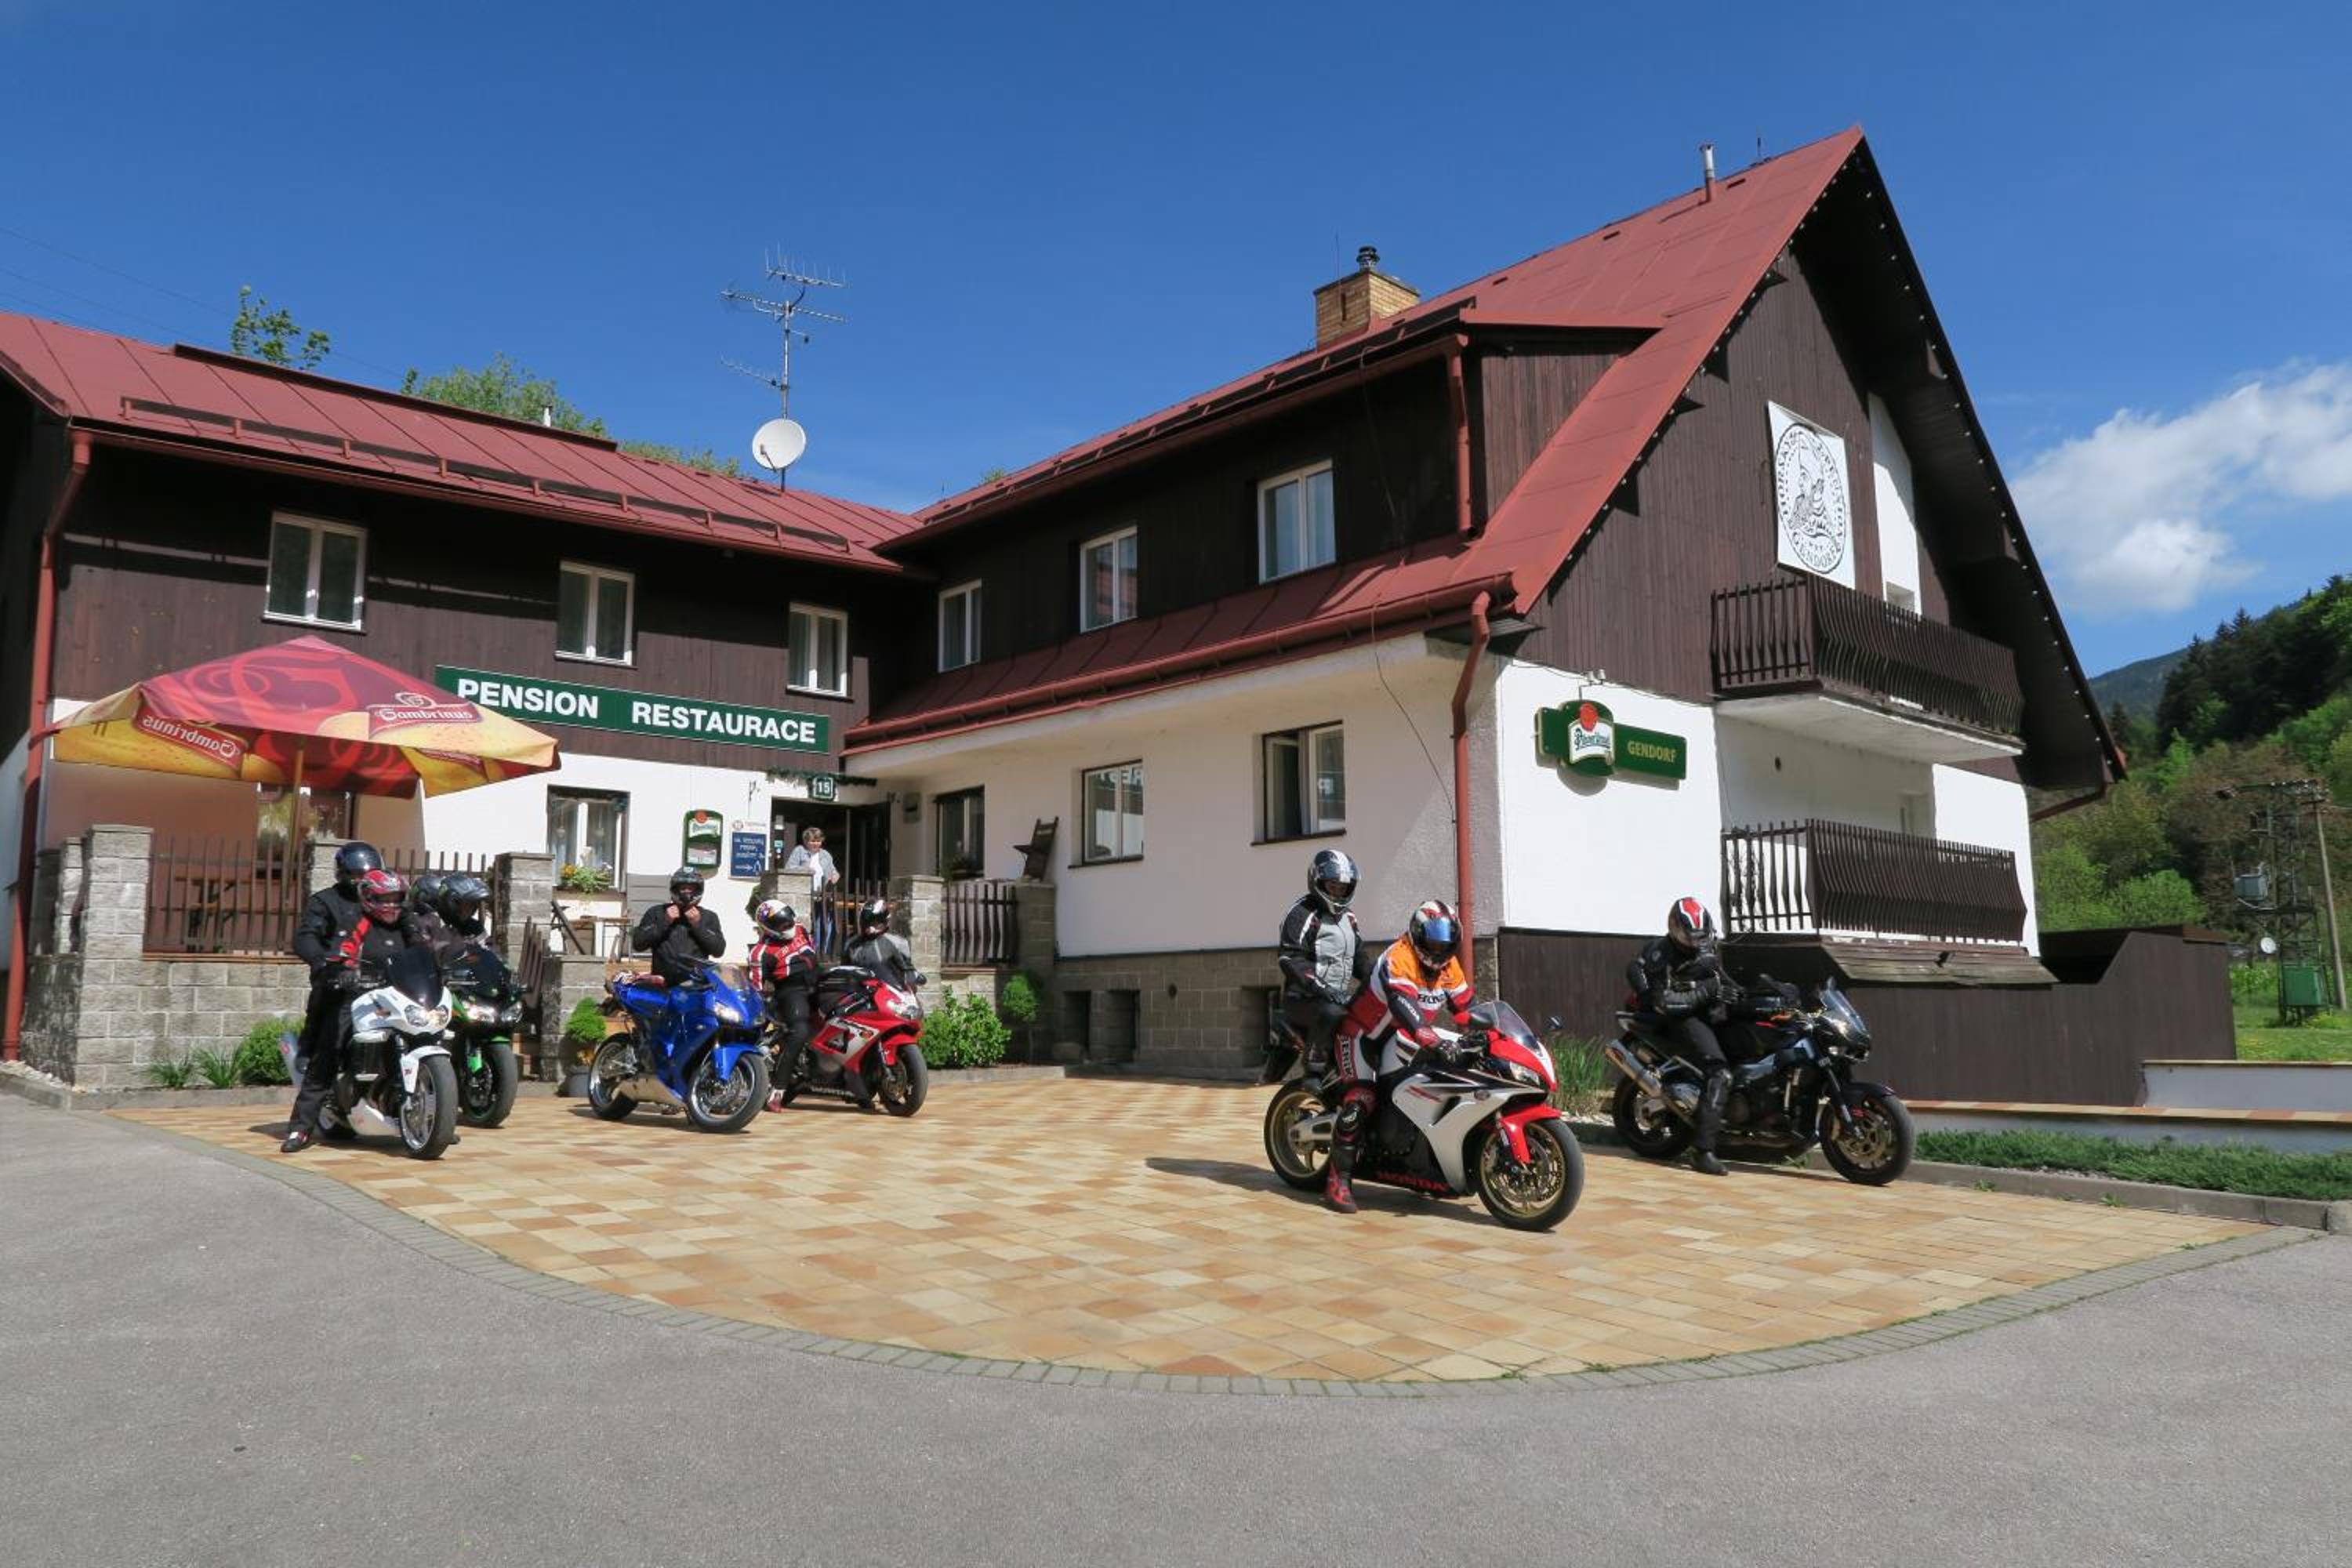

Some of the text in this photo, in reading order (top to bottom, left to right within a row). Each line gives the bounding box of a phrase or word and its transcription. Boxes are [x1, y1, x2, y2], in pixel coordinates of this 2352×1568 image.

[375, 708, 474, 722] Gambrinus
[457, 677, 817, 744] PENSION RESTAURACE
[1628, 740, 1676, 763] GENDORF
[818, 782, 830, 794] 15
